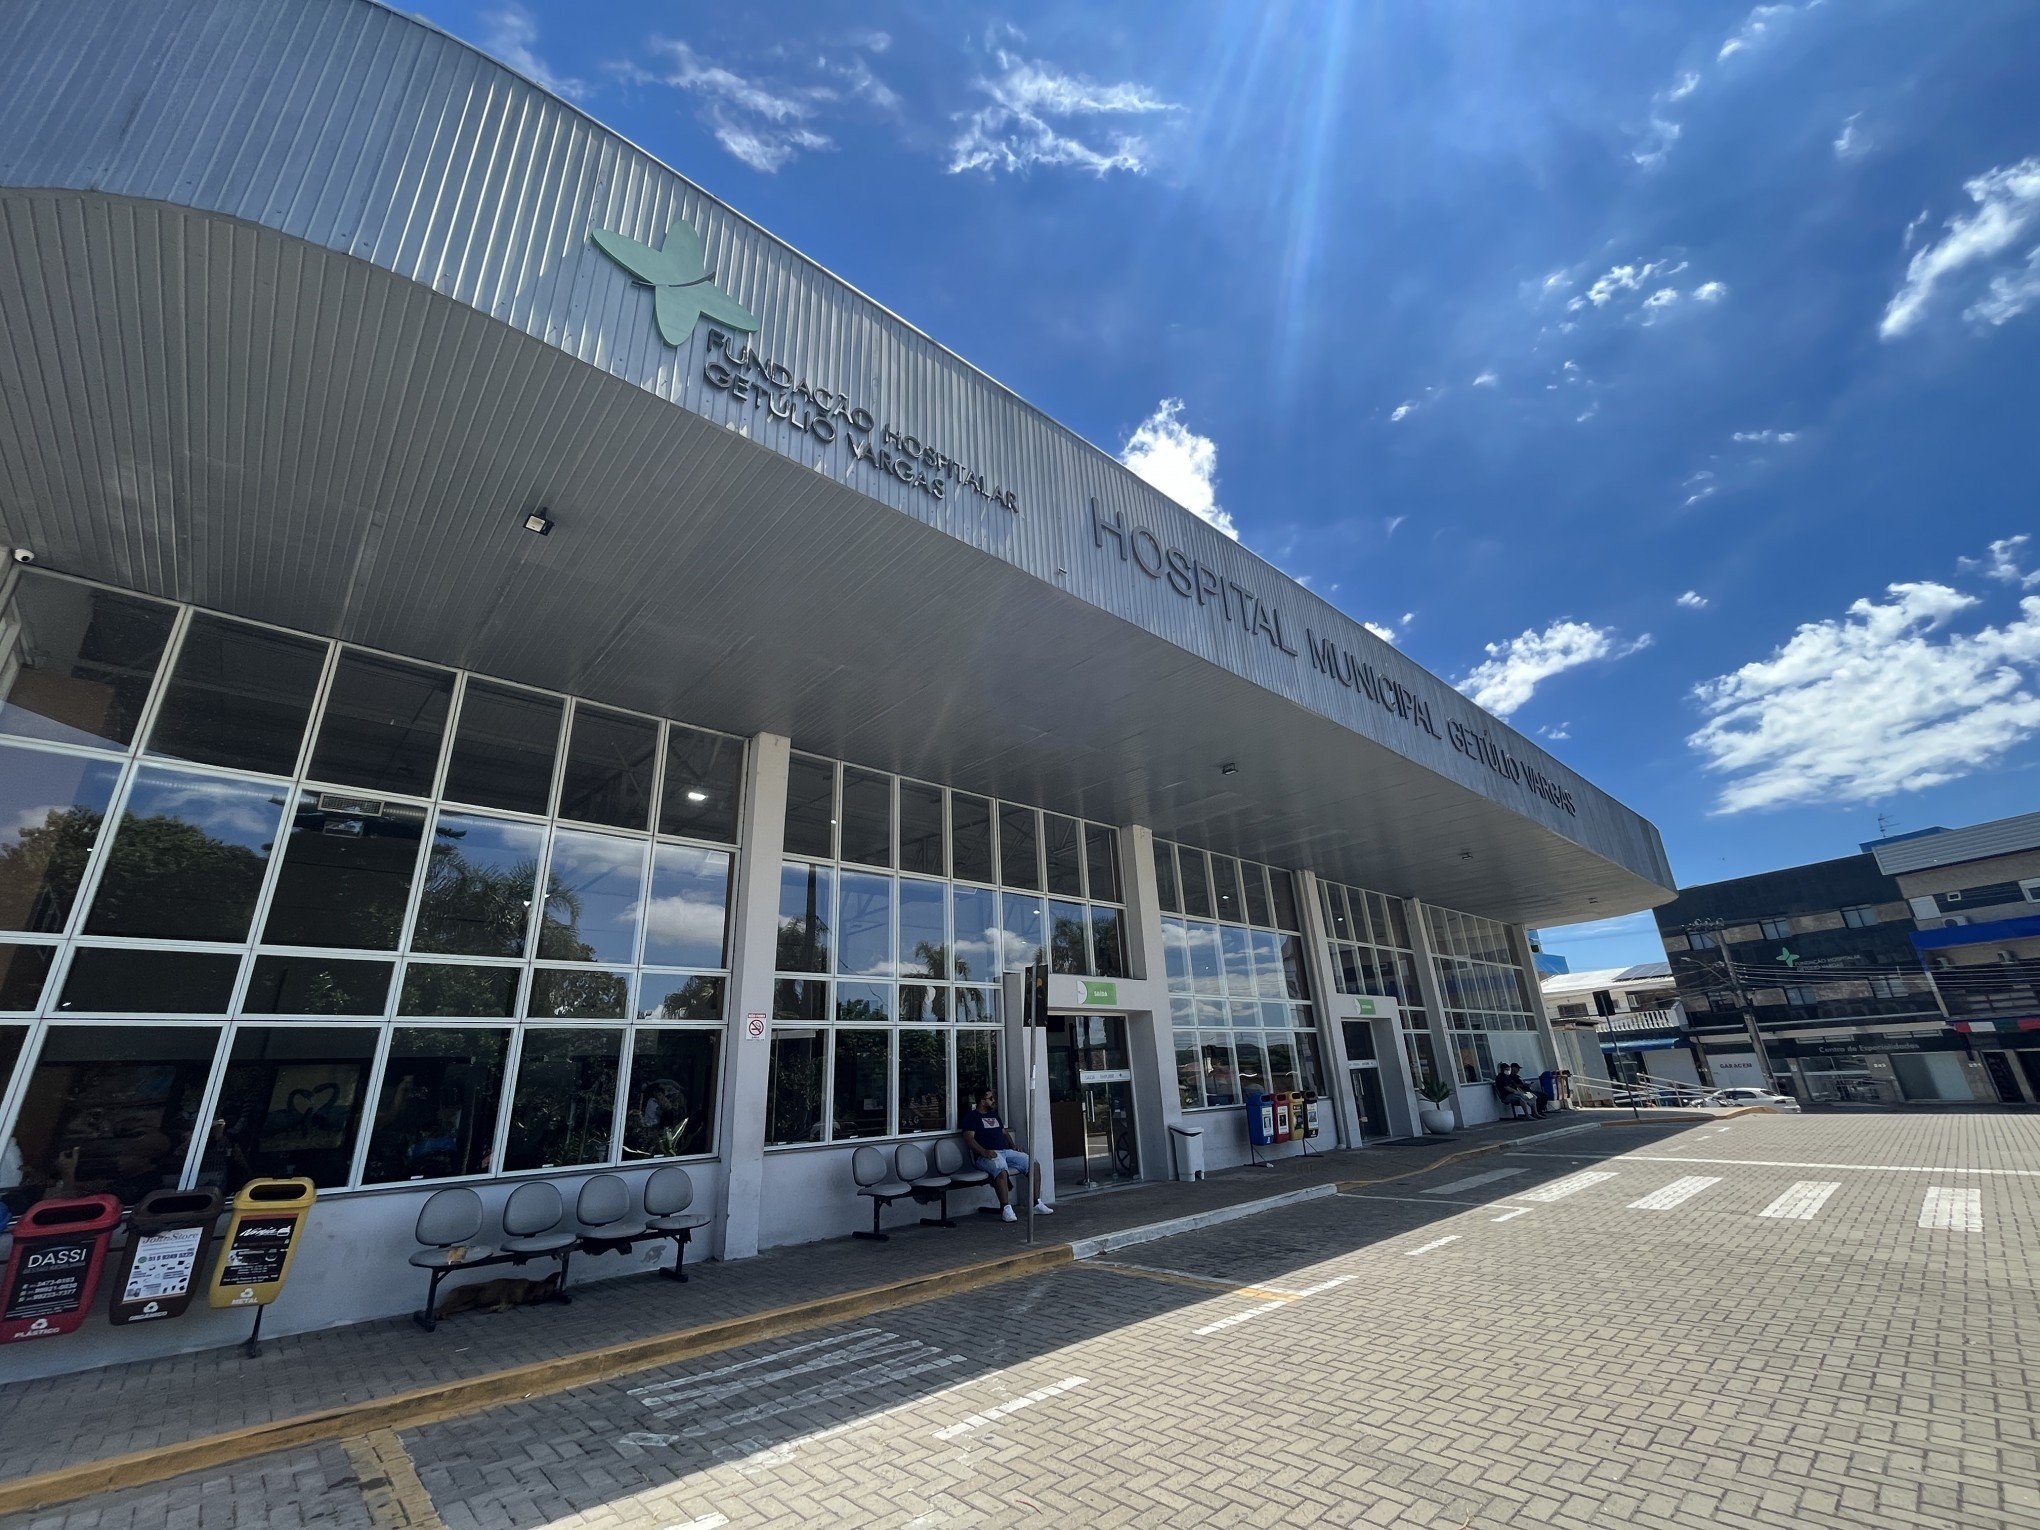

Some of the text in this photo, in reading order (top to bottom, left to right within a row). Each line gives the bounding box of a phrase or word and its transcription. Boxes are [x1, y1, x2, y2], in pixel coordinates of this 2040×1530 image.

[706, 328, 1019, 514] FUNDAÇÃO HOSPITALAR
[848, 431, 946, 500] VARGAS
[1091, 496, 1576, 817] HOSPITAL MUNICIPAL GETÚLIO VARGAS
[27, 1248, 87, 1268] DASSI
[14, 1327, 61, 1338] PLÁSTICO
